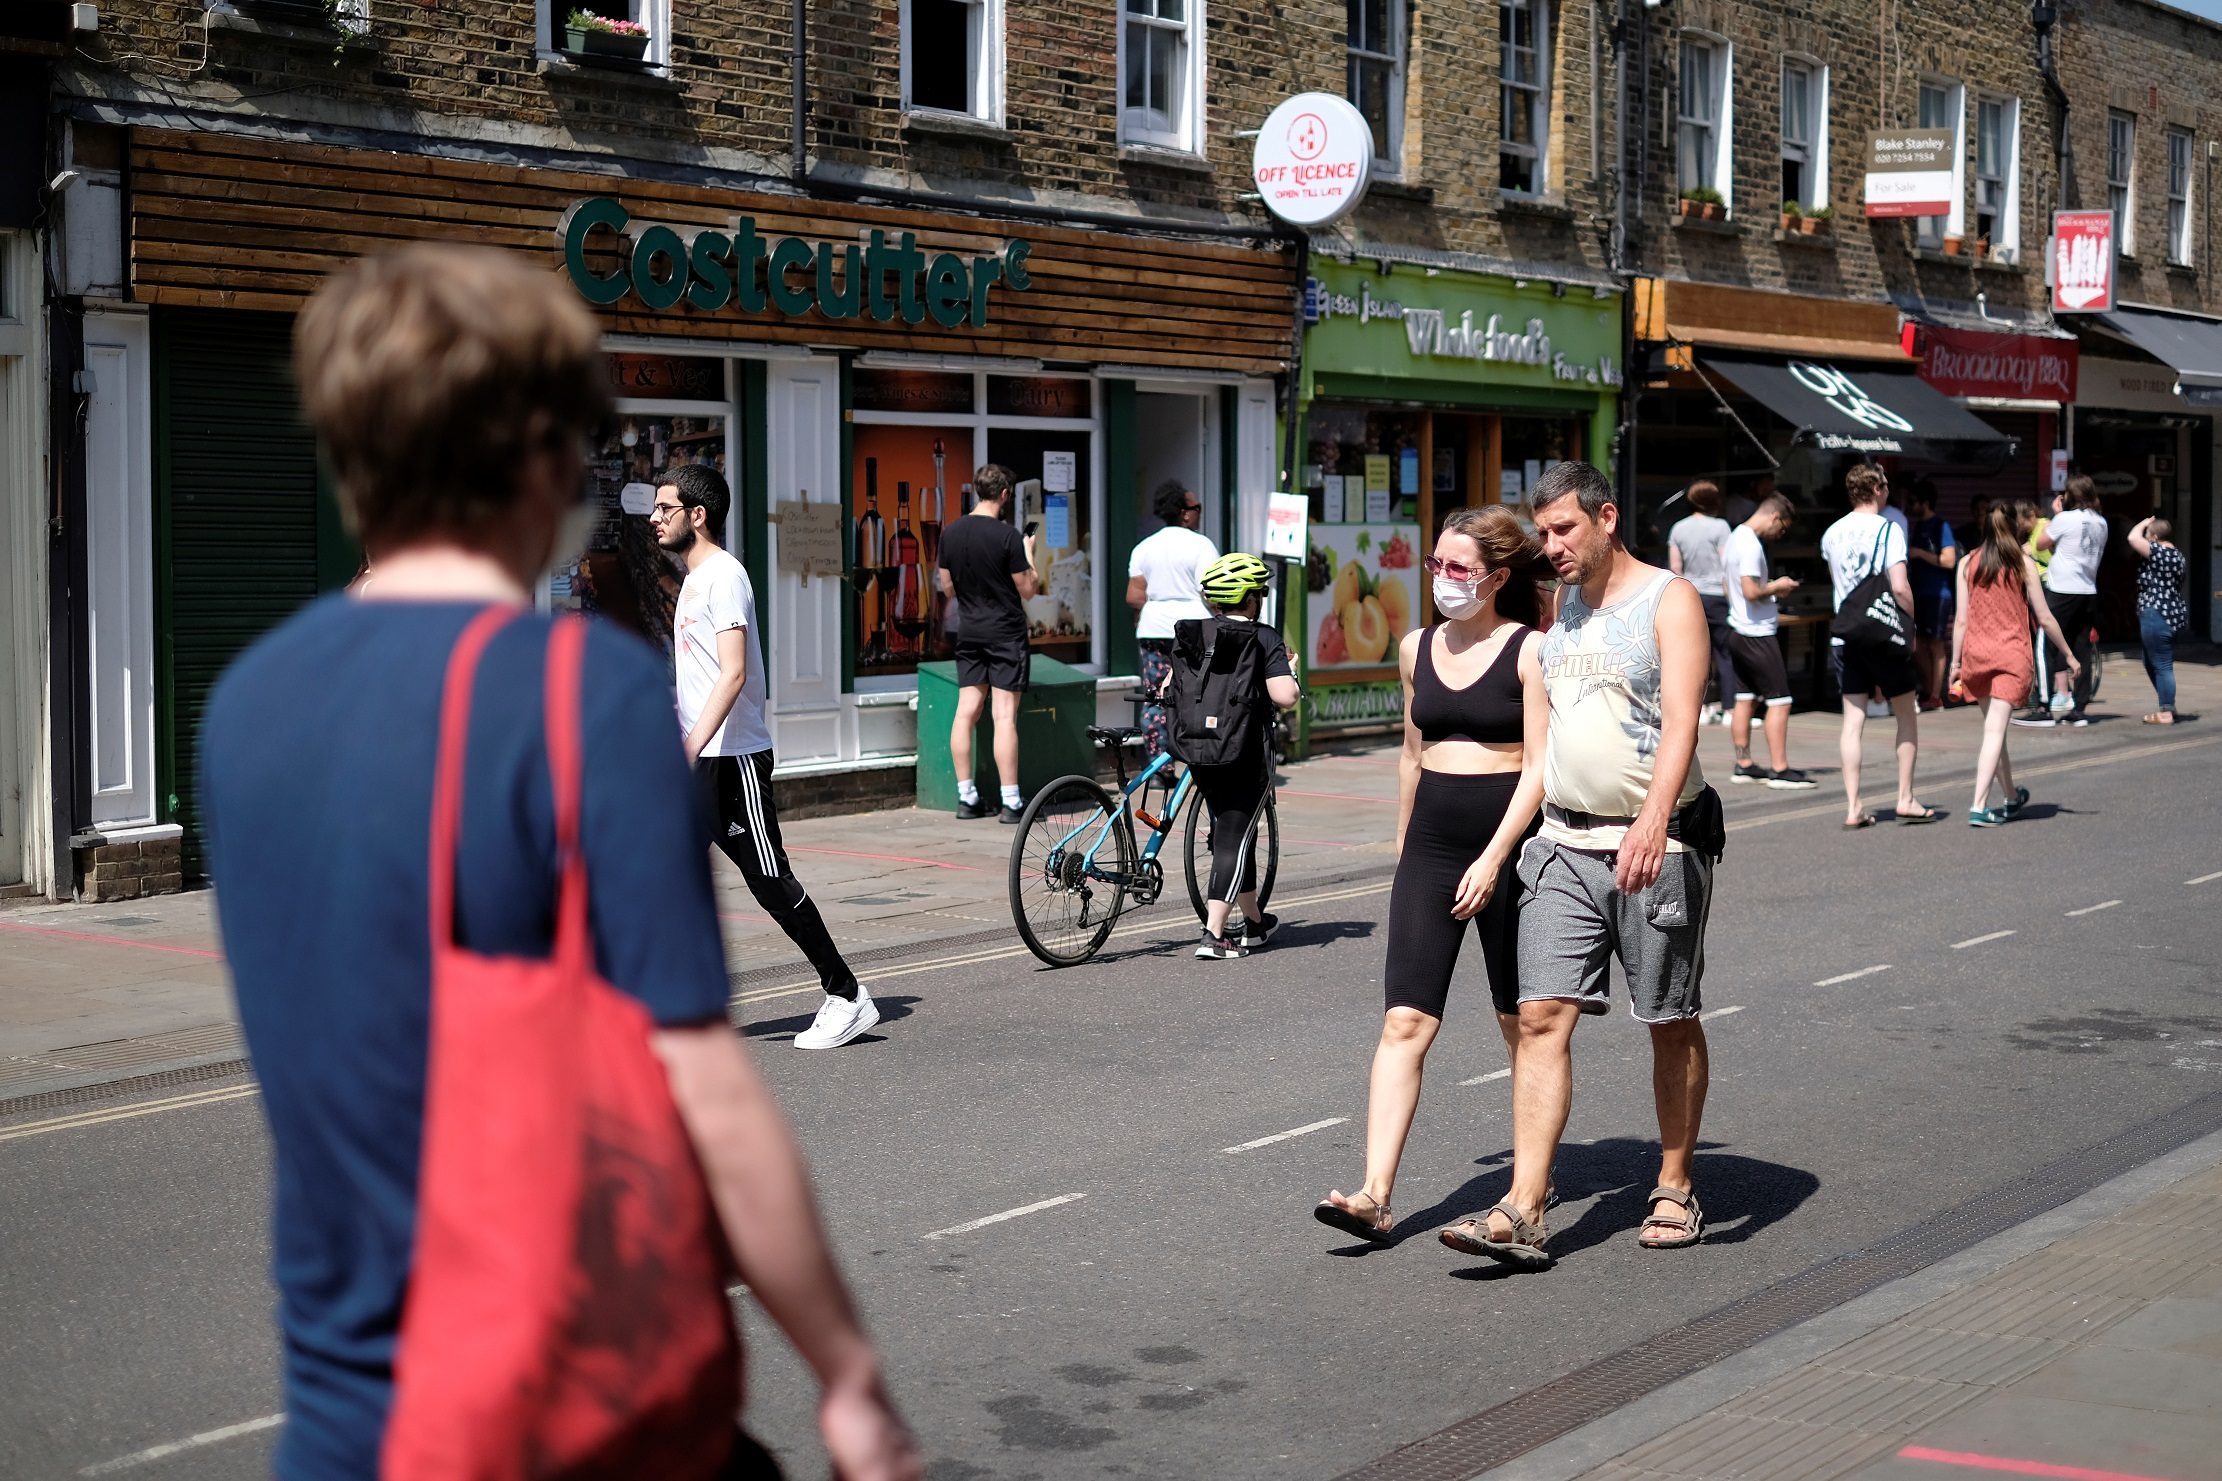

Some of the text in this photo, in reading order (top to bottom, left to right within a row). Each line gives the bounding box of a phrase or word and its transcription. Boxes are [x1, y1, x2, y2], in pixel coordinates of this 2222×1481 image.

[1874, 137, 1945, 151] Blake Stanley
[1258, 162, 1356, 186] OFF LICENCE
[1874, 182, 1916, 193] For Sale
[560, 196, 1001, 329] Costcutter
[635, 359, 657, 387] &
[663, 359, 713, 400] Veg
[2038, 354, 2070, 394] BBQ
[1008, 380, 1065, 415] Dairy
[1573, 677, 1625, 707] International
